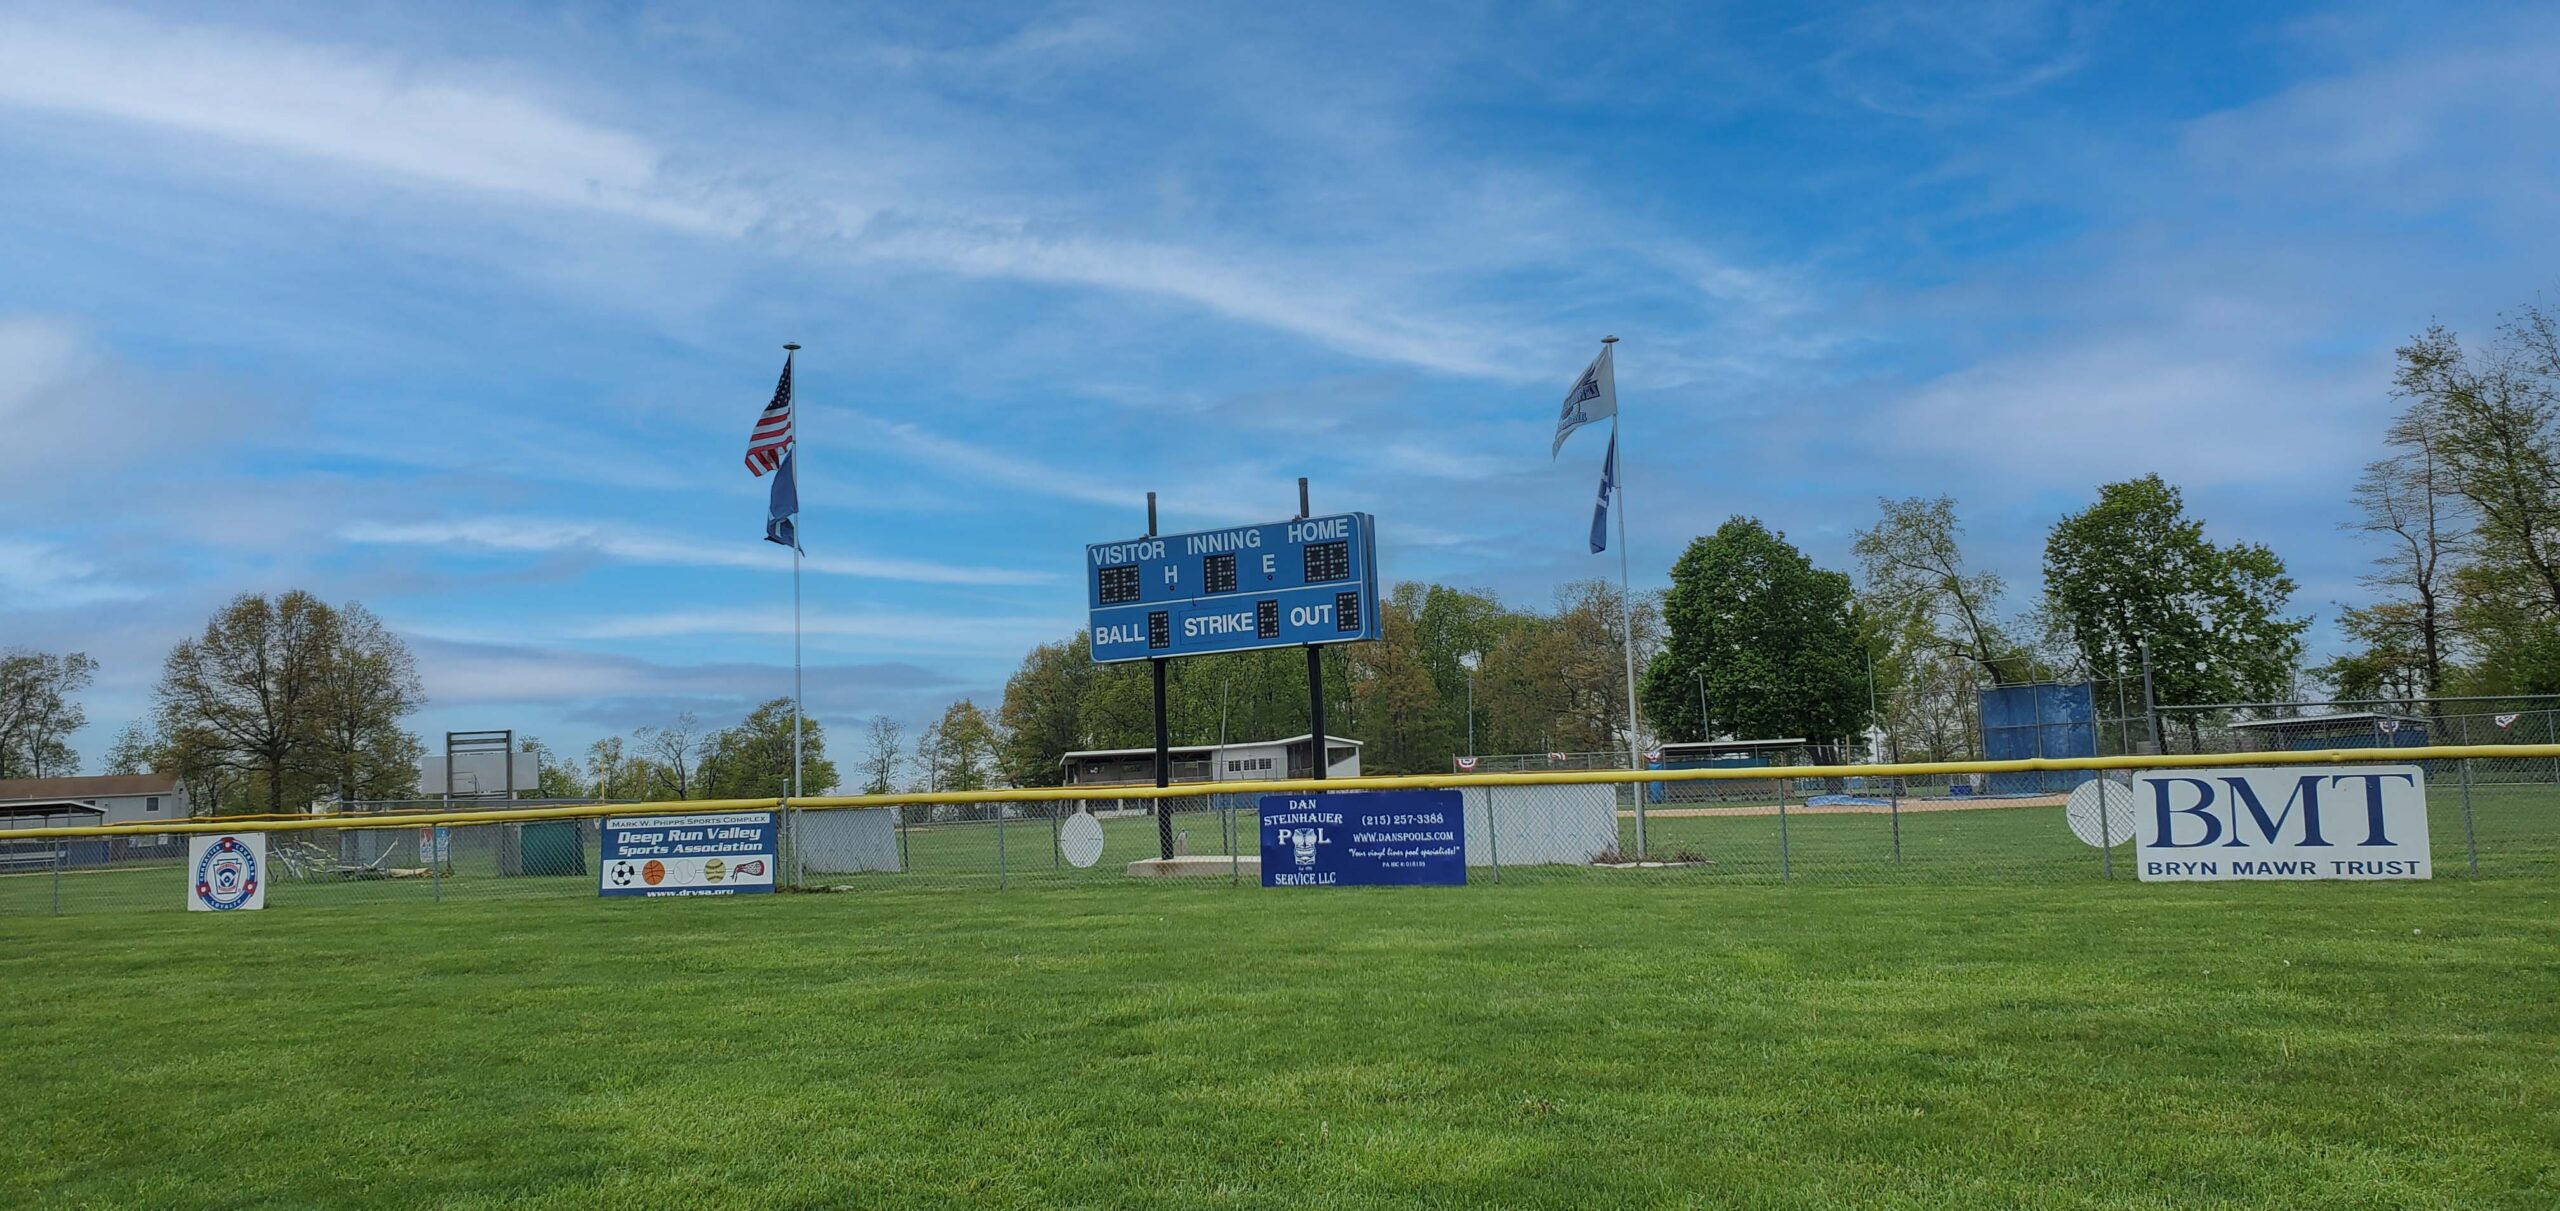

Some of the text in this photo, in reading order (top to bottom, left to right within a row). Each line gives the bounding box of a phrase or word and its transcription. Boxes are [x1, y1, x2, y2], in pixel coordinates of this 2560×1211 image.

[1288, 518, 1350, 544] HOME
[1092, 529, 1261, 565] VISITOR INNING
[1164, 554, 1276, 584] H E
[1096, 604, 1333, 645] BALL STRIKE OUT
[1289, 799, 1317, 810] DAN
[2142, 773, 2415, 848] BMT
[1263, 813, 1343, 826] STEINHAUER
[1362, 812, 1444, 826] (215) 257-3388
[617, 827, 761, 845] Deep Run Valley
[1352, 831, 1454, 843] WWW.DANSPOOLS.COM
[618, 842, 763, 857] Sports Association
[1367, 847, 1386, 859] vinyl
[1404, 846, 1419, 858] pool
[200, 845, 221, 882] CHARACTER
[235, 844, 256, 877] COURAGE
[2147, 860, 2420, 876] BRYN MAWR TRUST
[1275, 872, 1336, 886] SERVICE LLC
[210, 900, 242, 909] LOYALTY
